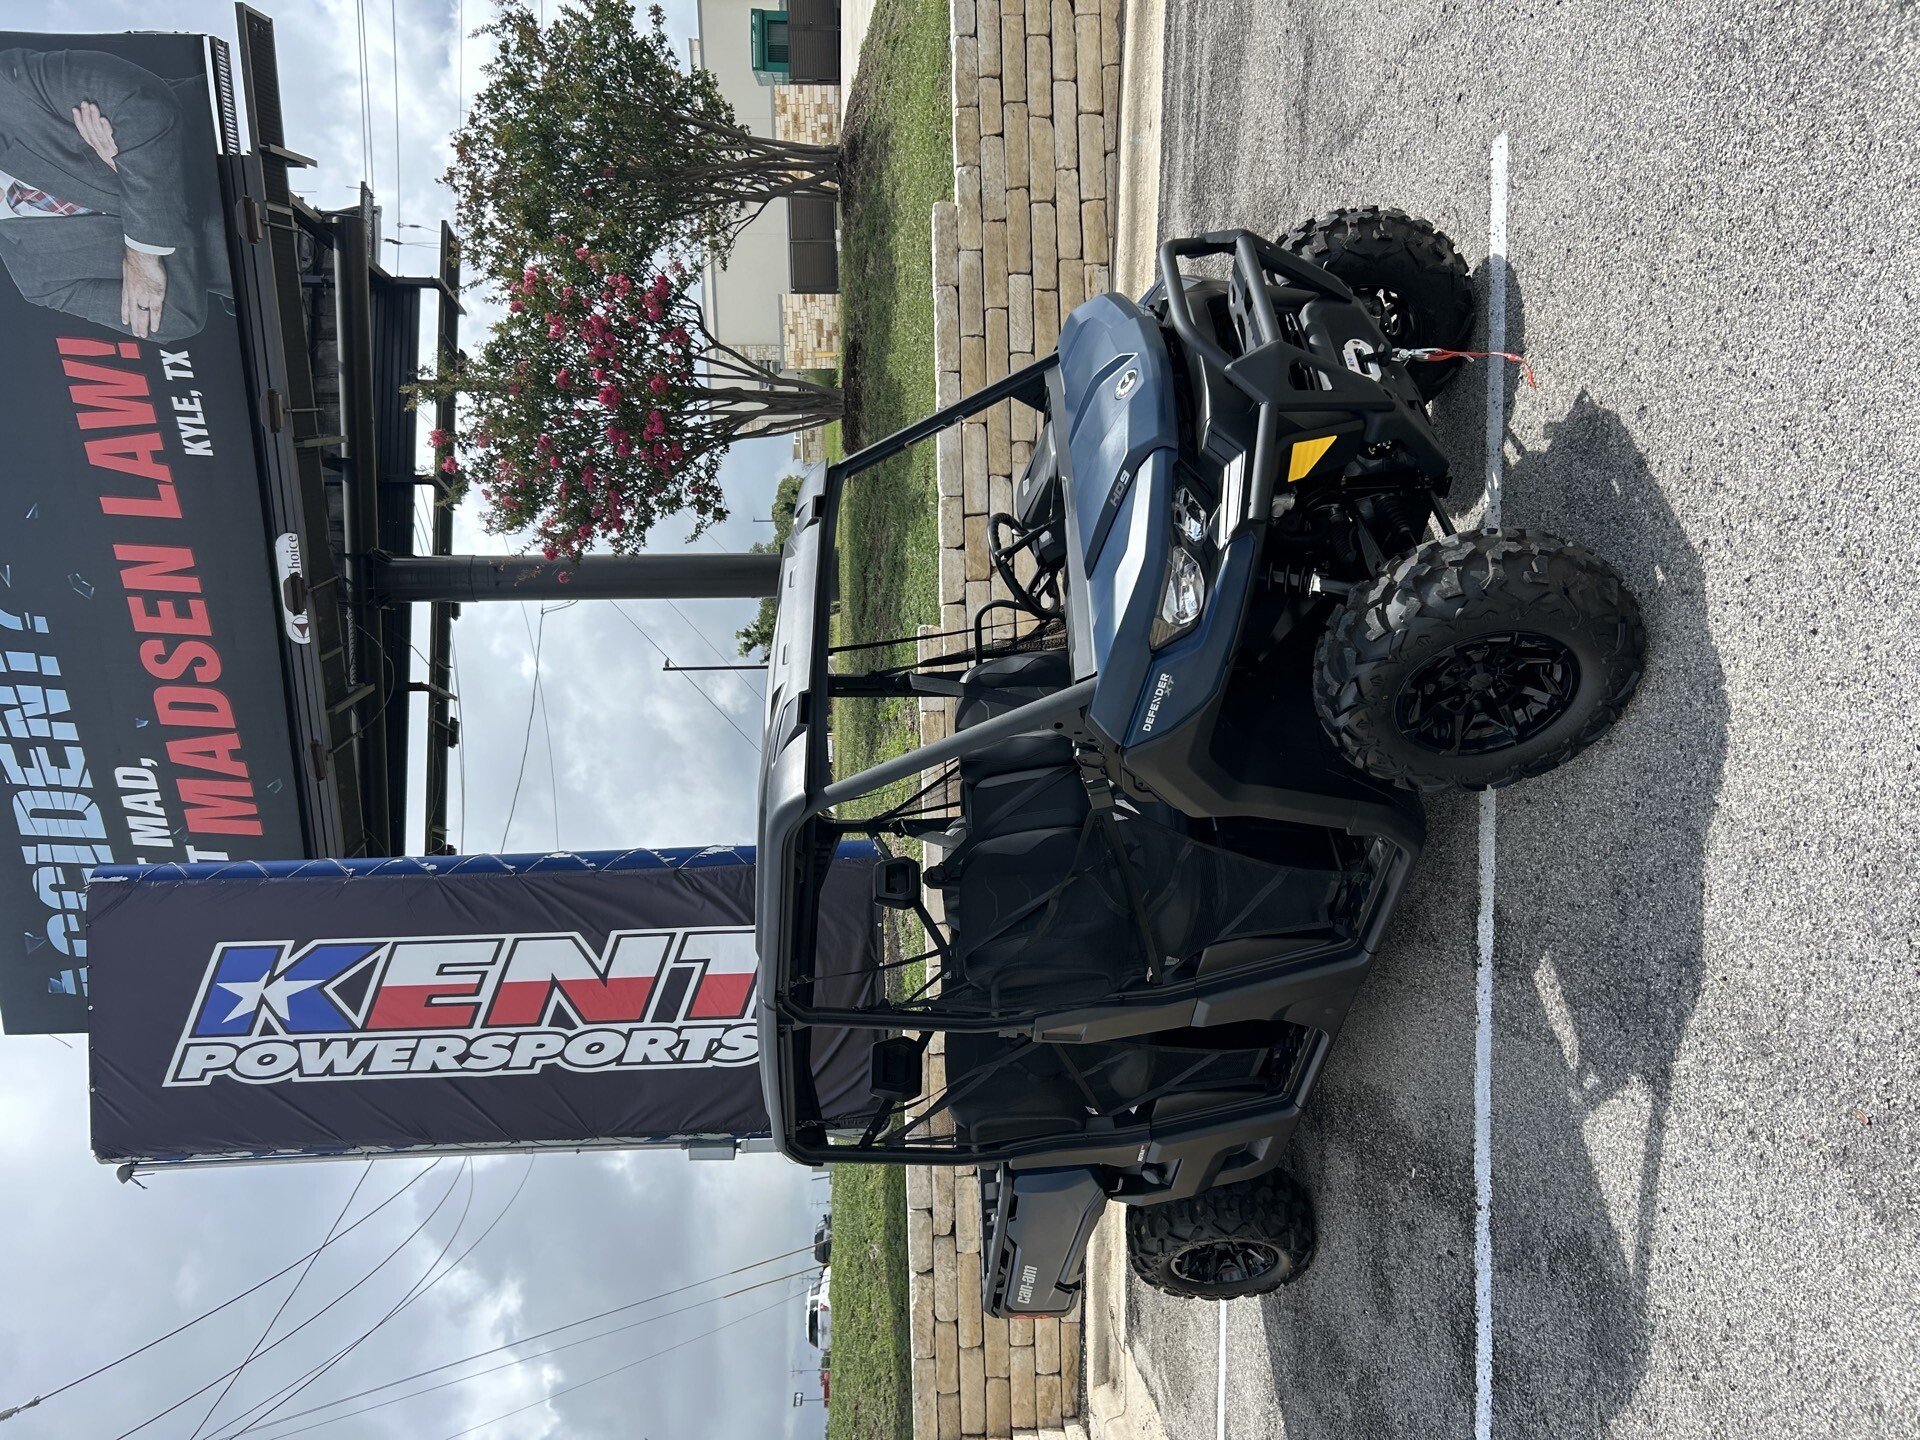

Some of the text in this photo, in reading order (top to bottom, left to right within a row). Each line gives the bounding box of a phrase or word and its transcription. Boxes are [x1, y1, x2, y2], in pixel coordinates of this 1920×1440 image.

[159, 349, 215, 457] KYLE, TX
[1109, 469, 1131, 508] HD9
[55, 336, 265, 837] MADSEN LAW!
[1142, 673, 1170, 732] DEFENDER
[1164, 675, 1175, 697] XT
[113, 757, 174, 848] MAD,
[188, 929, 760, 1037] KENT
[168, 1022, 761, 1084] POWERSPORTS
[1017, 1264, 1038, 1304] can-am
